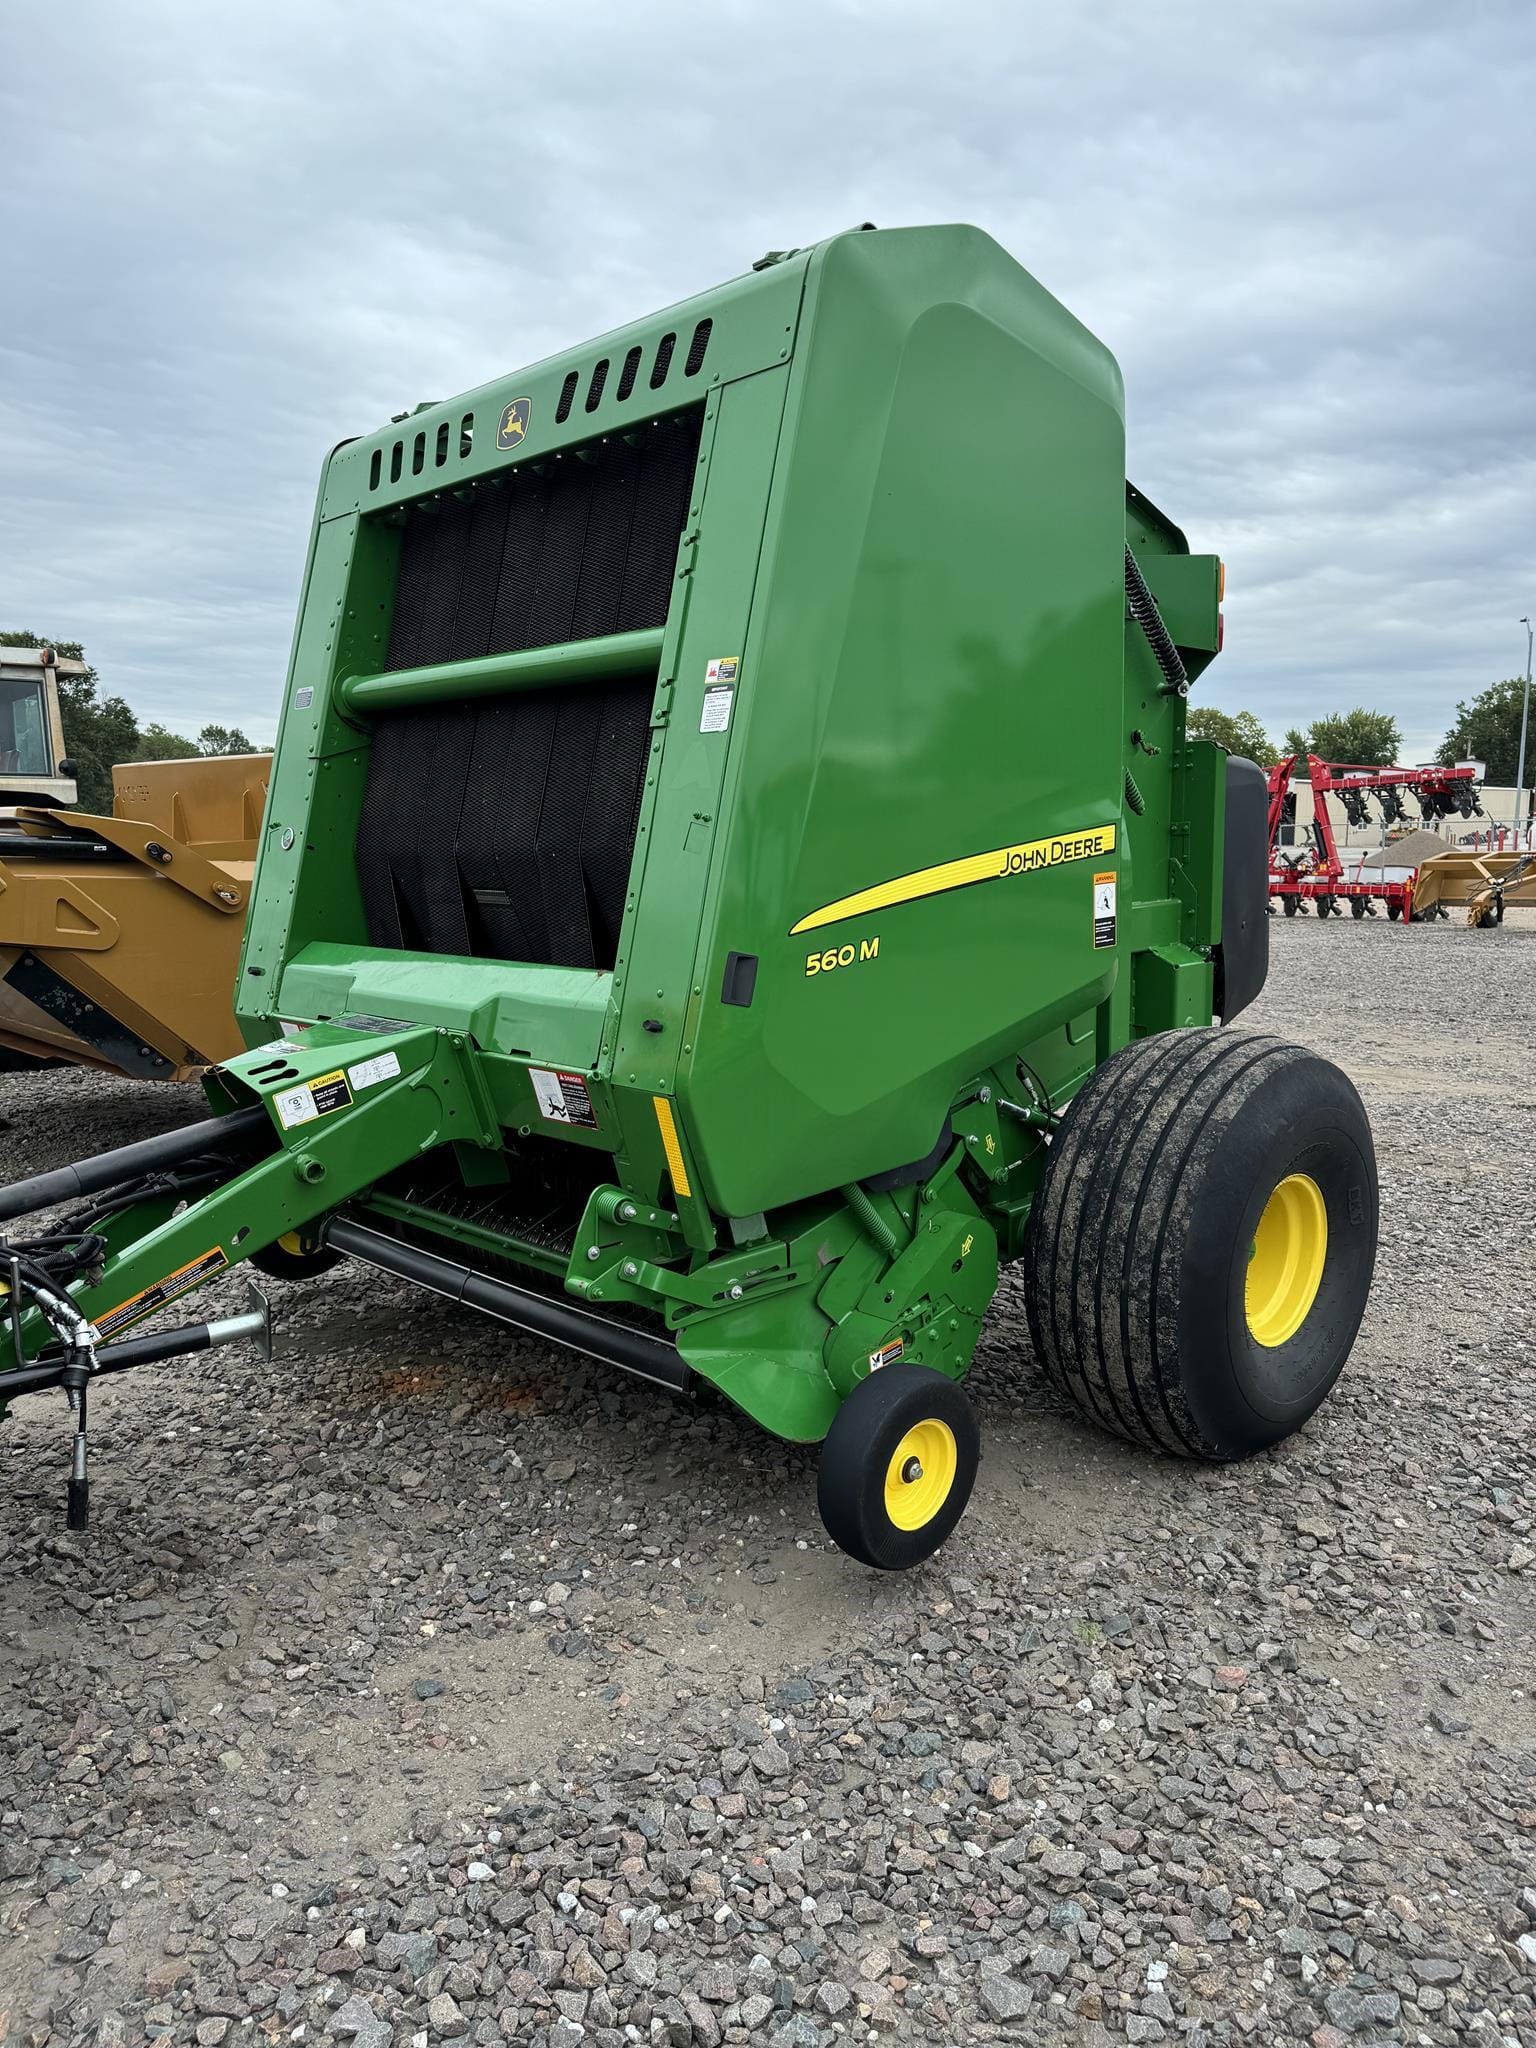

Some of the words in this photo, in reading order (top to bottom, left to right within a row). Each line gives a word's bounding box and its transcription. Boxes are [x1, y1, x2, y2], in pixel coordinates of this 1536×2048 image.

[1000, 848, 1046, 874] JOHN
[1051, 836, 1103, 861] DEERE
[805, 943, 856, 976] 560
[859, 936, 880, 962] M
[318, 1074, 340, 1085] CAUTION
[149, 1275, 173, 1292] WARNING
